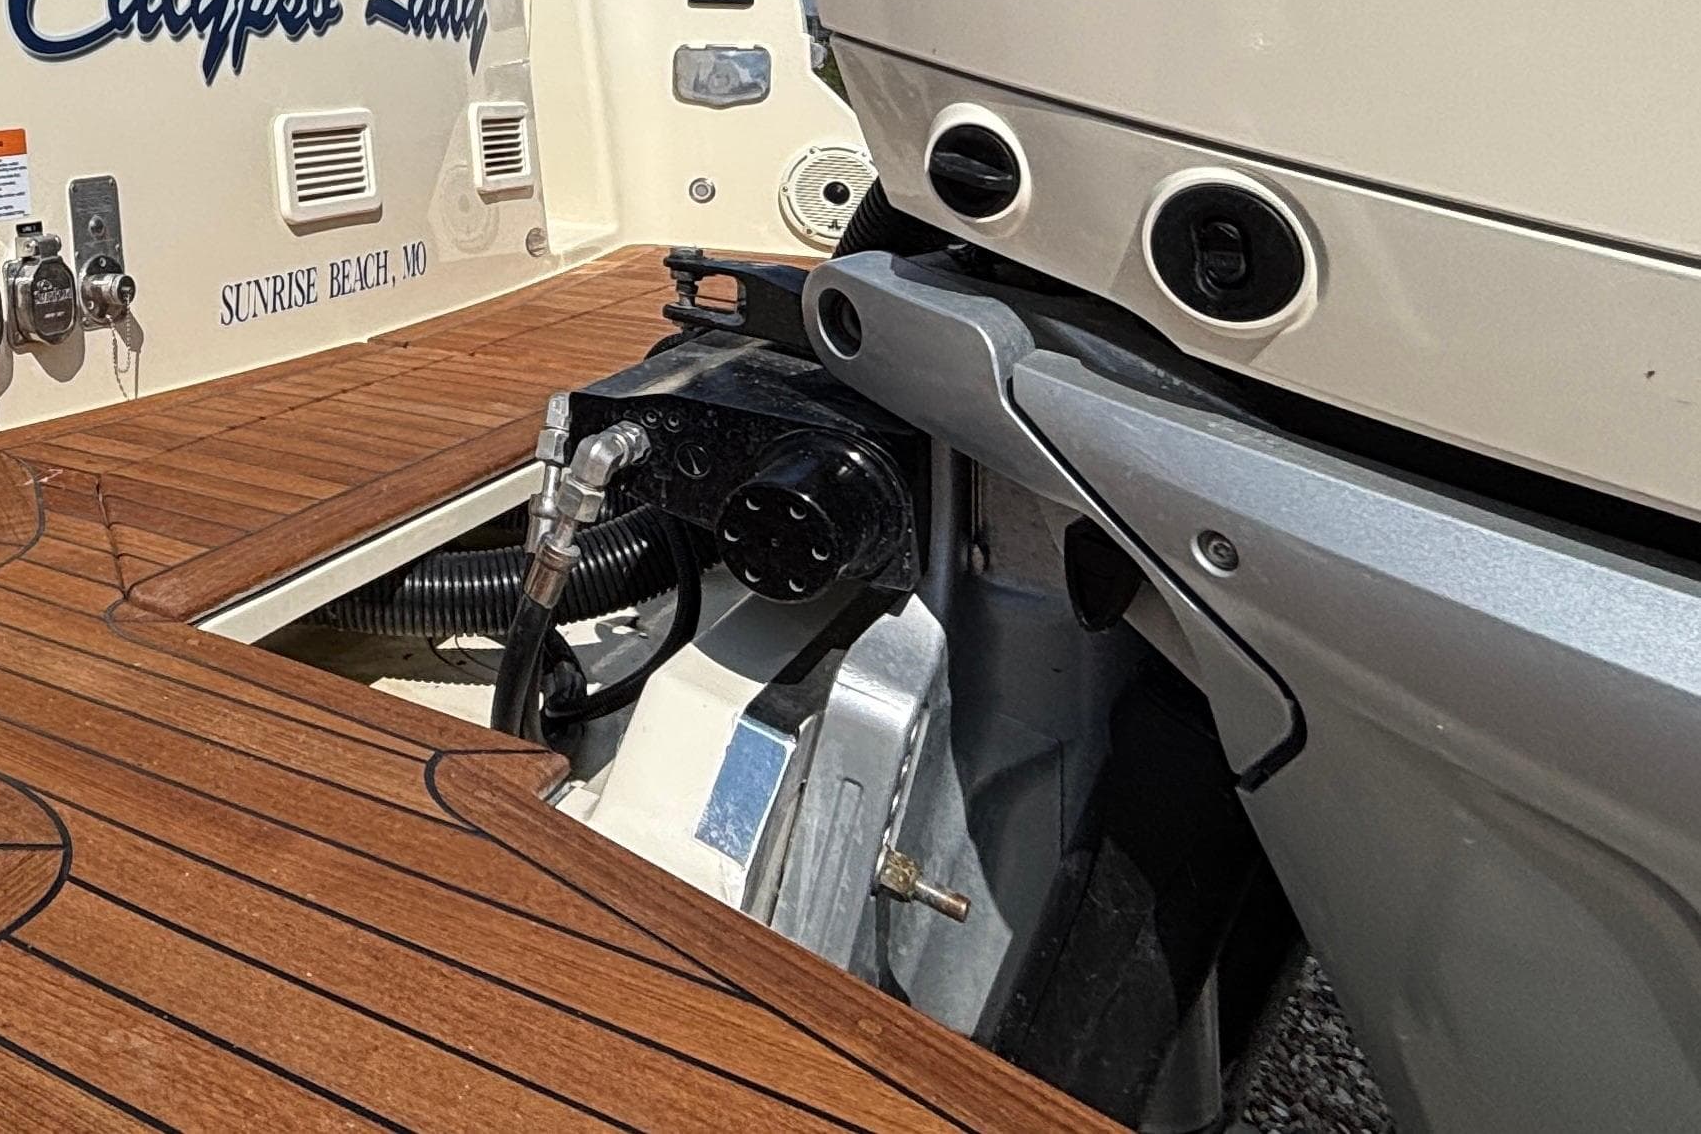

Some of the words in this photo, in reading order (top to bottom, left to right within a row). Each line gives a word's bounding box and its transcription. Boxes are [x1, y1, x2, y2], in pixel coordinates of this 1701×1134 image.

[220, 266, 318, 326] SUNRISE
[329, 250, 396, 299] BEACH,
[402, 241, 427, 280] MO
